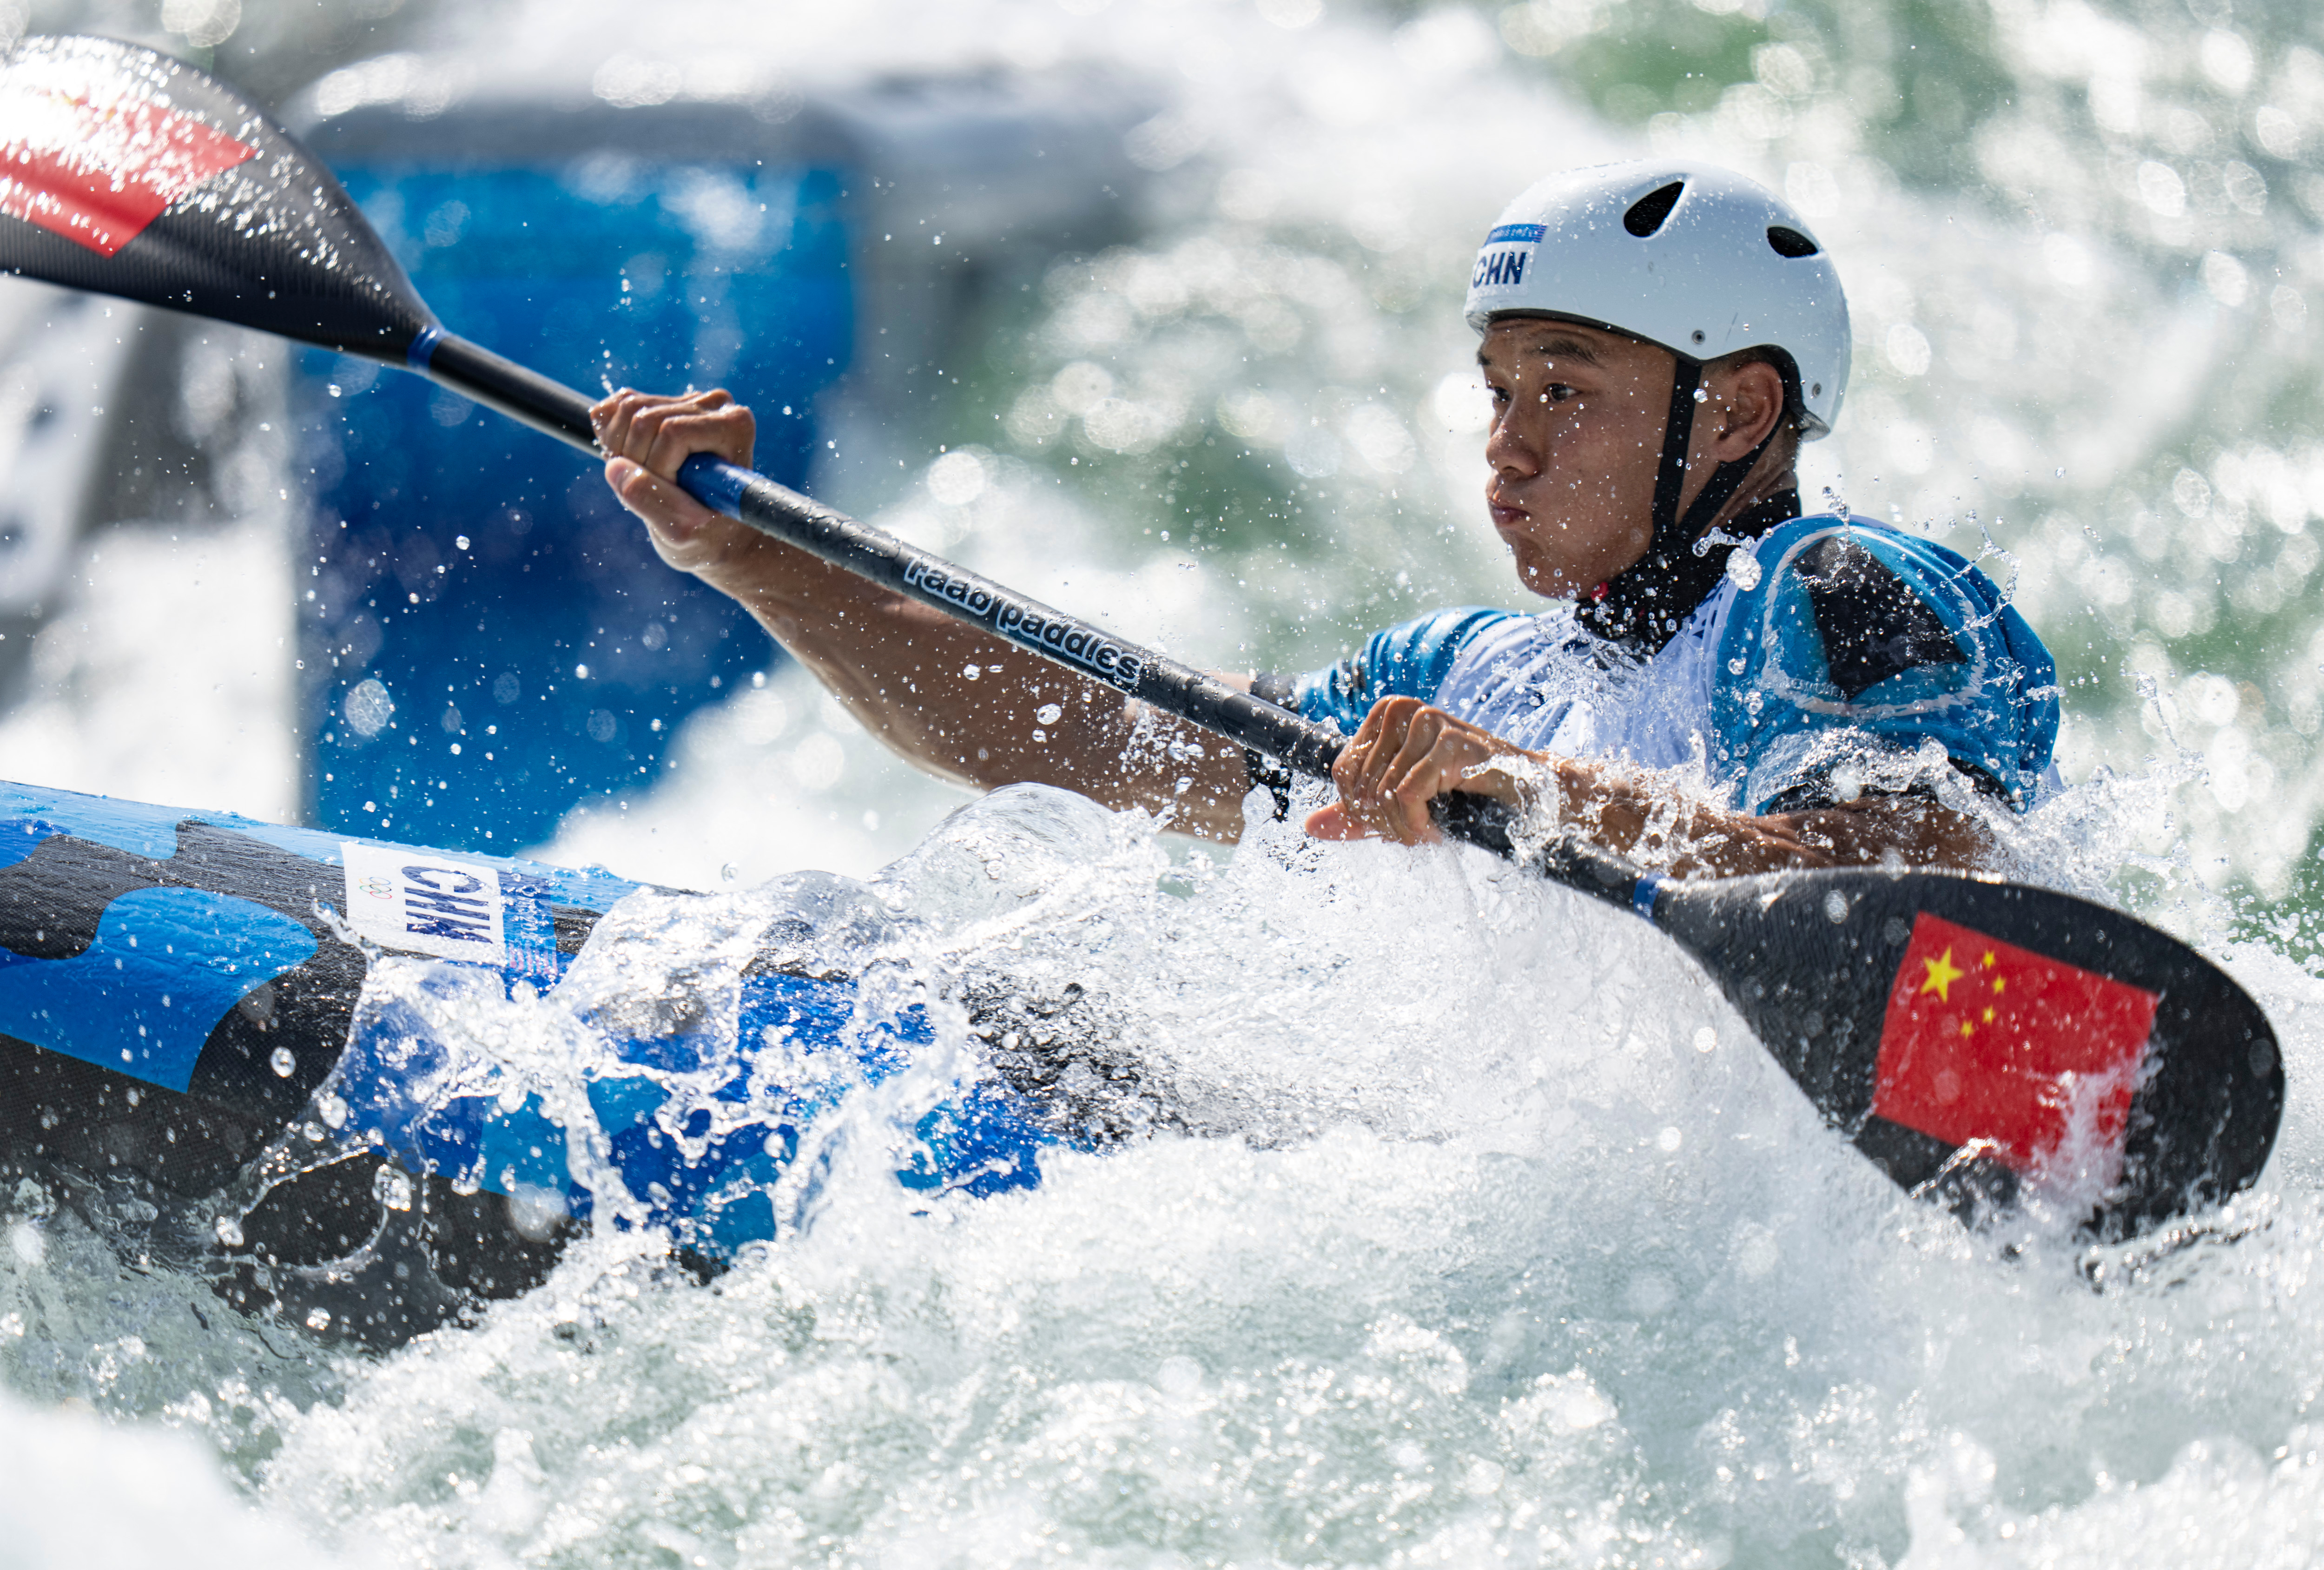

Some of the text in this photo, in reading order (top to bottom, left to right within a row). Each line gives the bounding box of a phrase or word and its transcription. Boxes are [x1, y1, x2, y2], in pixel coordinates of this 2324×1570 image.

[1473, 251, 1527, 289] CHN
[904, 557, 1141, 683] raab paddles
[401, 865, 493, 944] CHN
